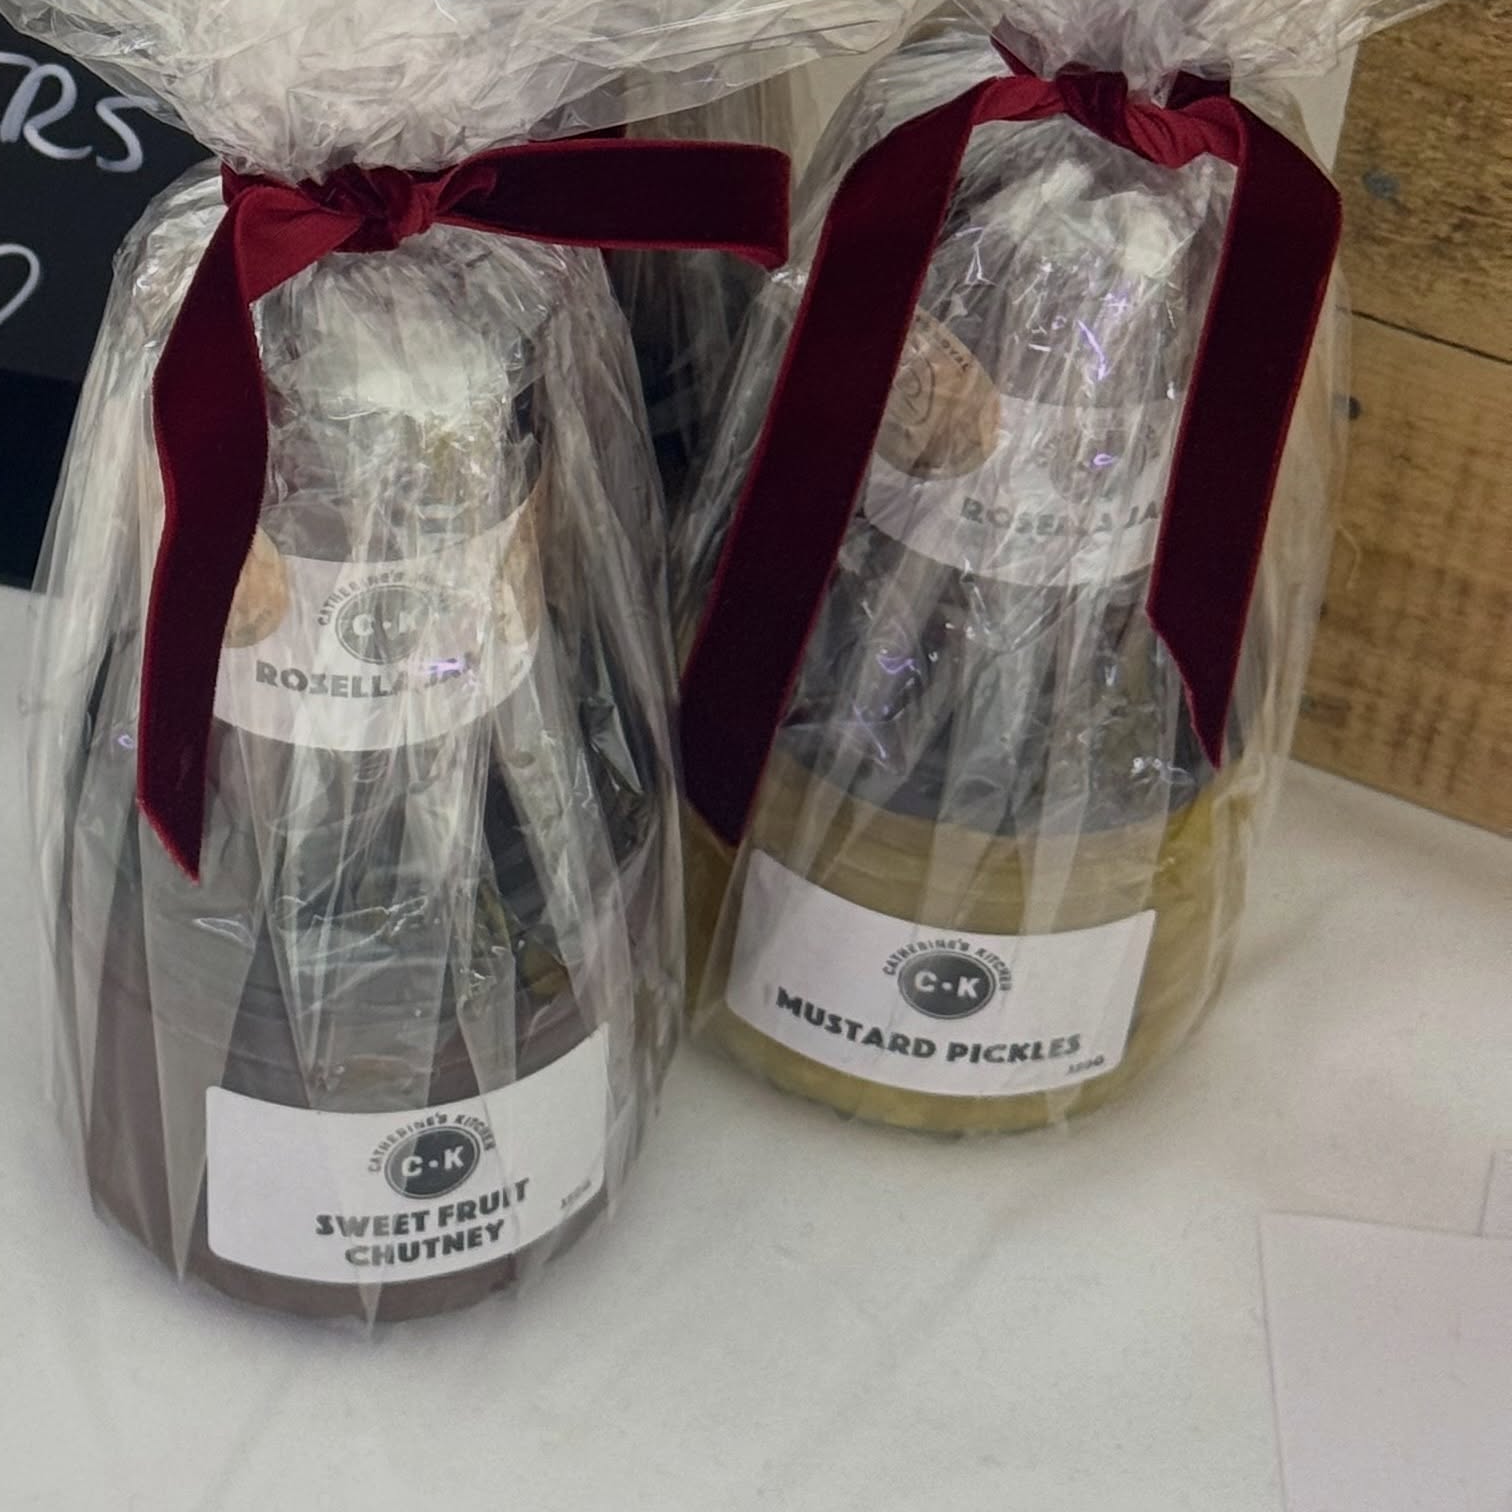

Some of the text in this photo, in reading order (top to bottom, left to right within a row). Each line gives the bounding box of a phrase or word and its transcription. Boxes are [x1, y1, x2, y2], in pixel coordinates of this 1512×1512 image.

[776, 985, 1081, 1065] MUSTARD PICKLES
[315, 1210, 430, 1239] SWEET
[438, 1178, 530, 1228] FRUIT
[344, 1218, 505, 1267] CHUTNEY
